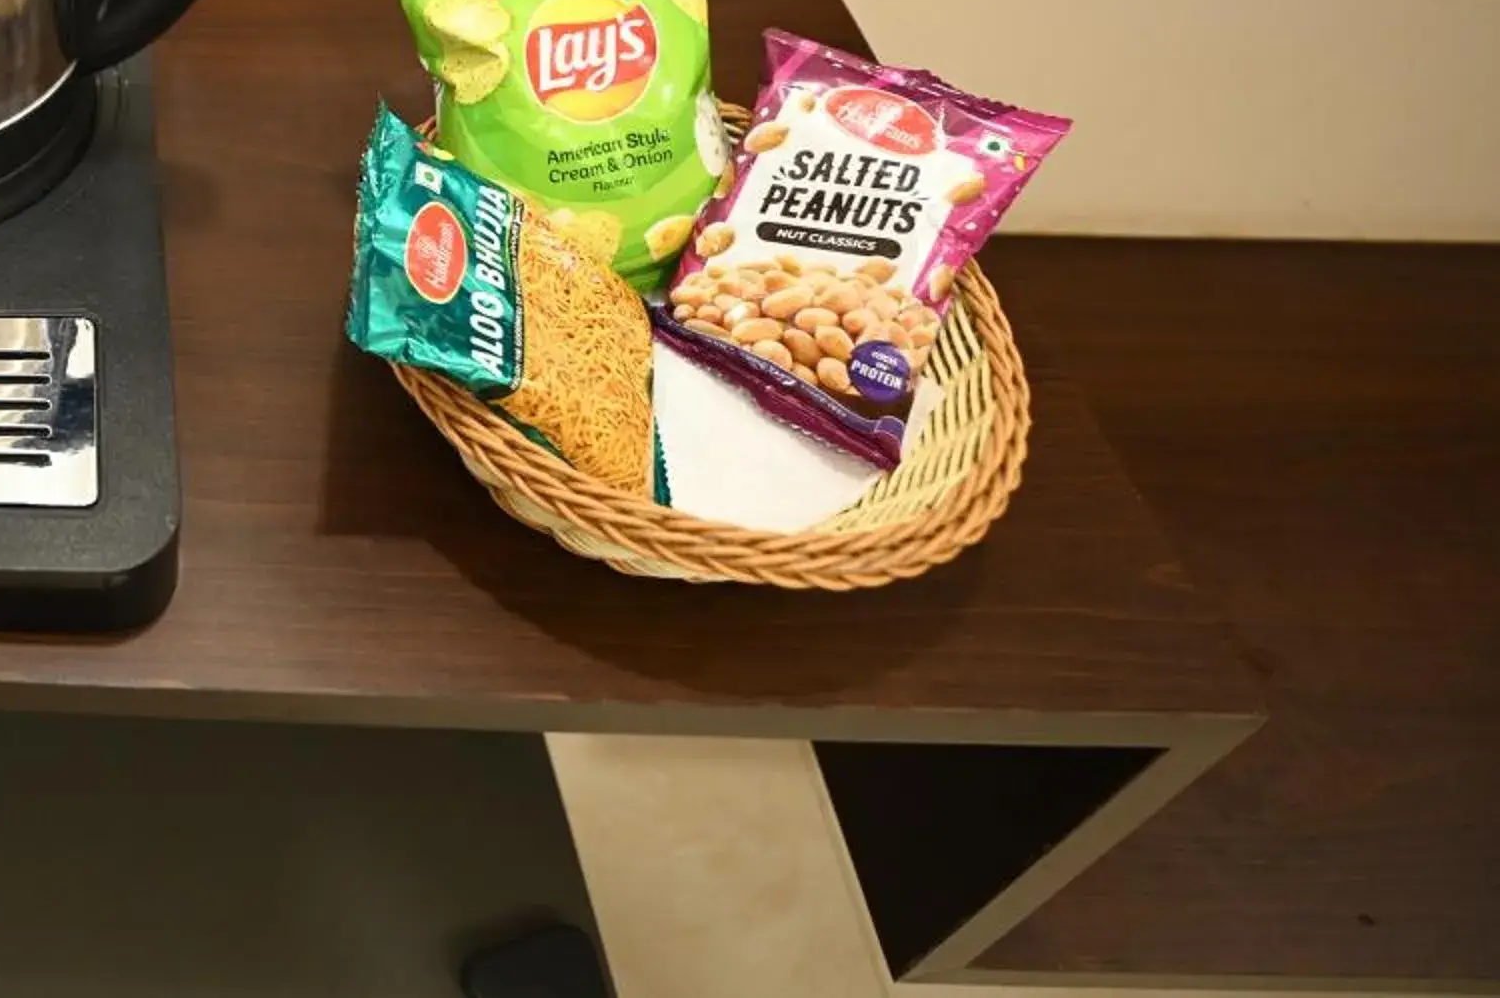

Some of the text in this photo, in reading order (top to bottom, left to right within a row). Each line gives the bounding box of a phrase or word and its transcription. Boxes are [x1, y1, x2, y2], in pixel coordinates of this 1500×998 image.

[538, 12, 646, 92] Lay's
[548, 128, 671, 166] American Style
[549, 149, 673, 183] Cream & Onion
[788, 150, 921, 193] SALTED
[759, 184, 923, 234] PEANUTS
[776, 228, 877, 251] NUT CLASSICS
[469, 185, 509, 379] ALOO BHUJIA
[851, 360, 904, 389] PROTEIN
